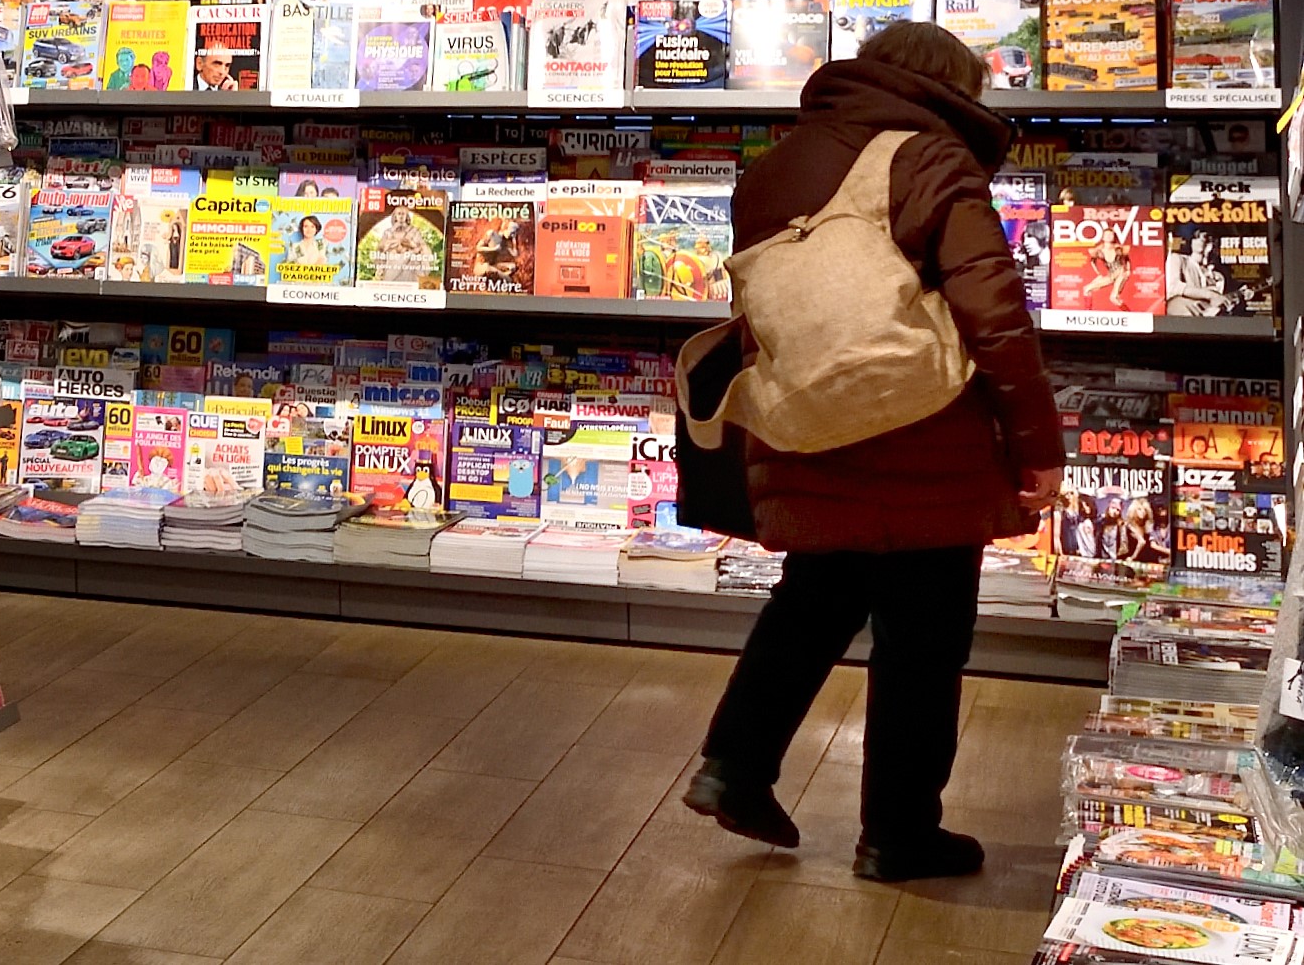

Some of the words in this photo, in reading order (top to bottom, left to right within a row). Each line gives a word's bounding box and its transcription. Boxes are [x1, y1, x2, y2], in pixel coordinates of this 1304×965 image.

[196, 7, 262, 19] CAUSEUR
[28, 29, 49, 39] SUV
[50, 26, 98, 37] URBAINS
[447, 36, 495, 50] VIRUS
[655, 35, 699, 49] Fusion
[1064, 41, 1144, 53] NUREMBERG
[364, 46, 423, 59] PHYSIQUE
[655, 47, 710, 61] nucléaire
[285, 92, 345, 103] ACTUALITÉ
[547, 92, 604, 104] SCIENCES
[1169, 93, 1207, 104] PRESSE
[1212, 93, 1277, 104] SPÉCIALISÉE
[469, 150, 538, 167] ESPÈCES
[2, 183, 17, 198] 6
[492, 186, 536, 197] Recherche
[1200, 179, 1251, 195] Rock
[195, 198, 257, 215] Capital
[386, 193, 444, 209] tangente
[192, 223, 267, 235] IMMOBILIER
[1053, 206, 1164, 246] BOWIE
[1220, 236, 1240, 249] JEFF
[1242, 236, 1267, 248] BECK
[276, 264, 300, 274] OSEZ
[303, 265, 339, 274] PARLER
[282, 289, 340, 301] ÉCONOMIE
[373, 292, 427, 304] SCIENCES
[1066, 316, 1129, 327] MUSIQUE
[169, 332, 203, 354] 60
[65, 348, 109, 368] evo
[57, 369, 104, 383] AUTO
[213, 363, 281, 380] Rebondir
[57, 382, 124, 398] HEROES
[364, 384, 439, 405] micro
[1184, 378, 1280, 397] GUITARE
[190, 415, 219, 428] QUE
[361, 416, 408, 438] Linux
[464, 428, 513, 445] LINUX
[214, 443, 250, 455] ACHATS
[354, 445, 410, 458] DOMPTER
[212, 453, 225, 463] EN
[227, 454, 252, 464] LIGNE
[354, 454, 412, 474] LINUX
[26, 463, 93, 474] NOUVEAUTÉS
[1176, 466, 1236, 486] jazz
[1186, 551, 1257, 572] mondes
